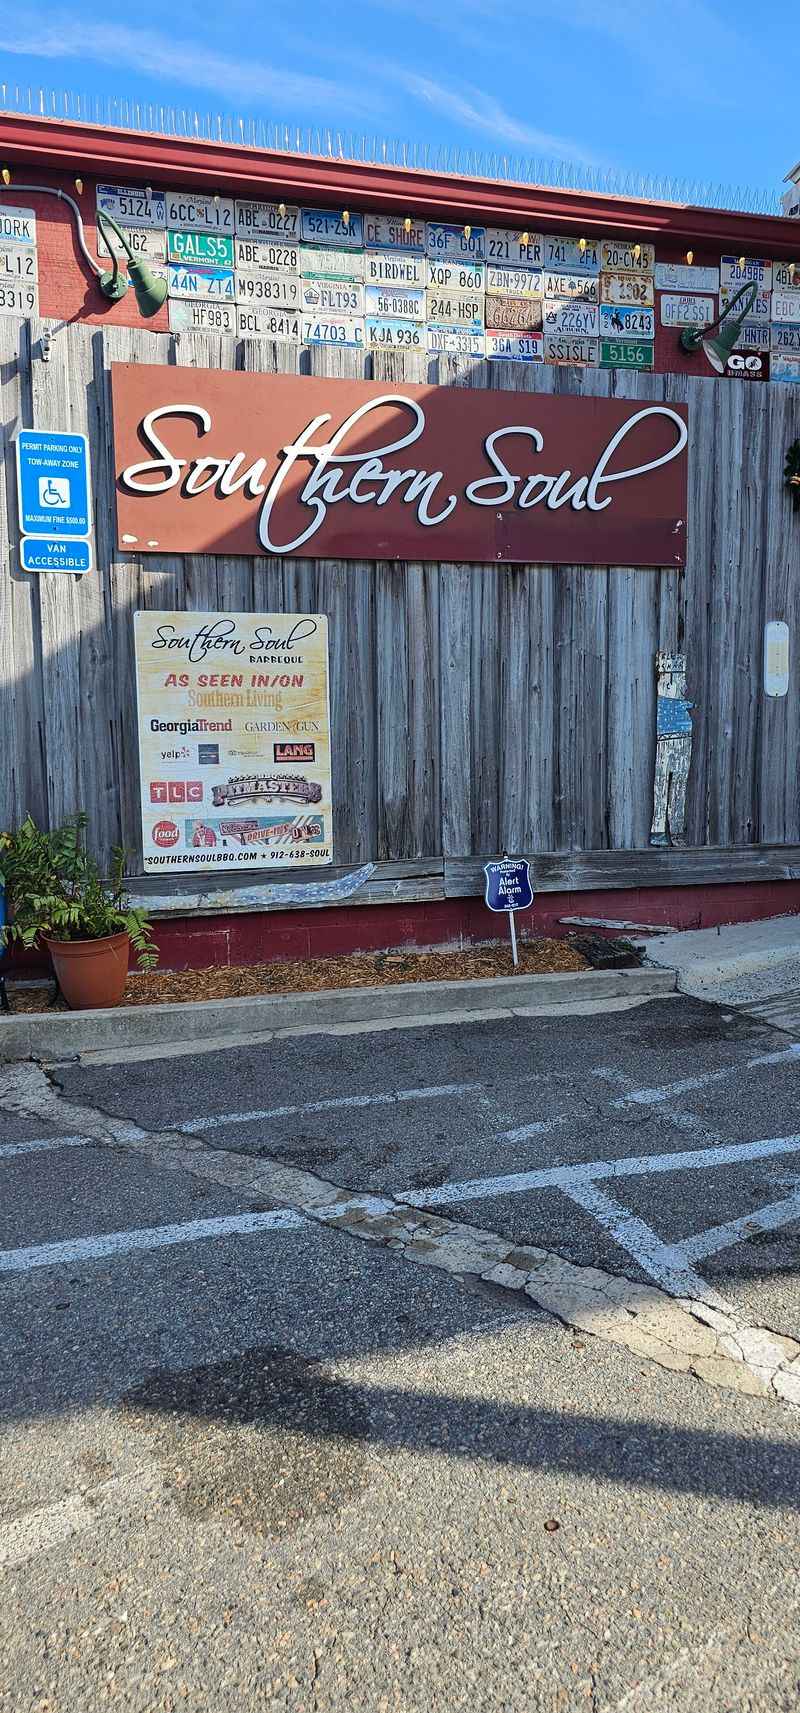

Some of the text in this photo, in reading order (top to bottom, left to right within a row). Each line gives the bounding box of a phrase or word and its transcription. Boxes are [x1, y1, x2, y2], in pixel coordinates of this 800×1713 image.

[120, 197, 151, 217] 5124
[169, 203, 231, 227] 6CC L12
[238, 209, 297, 231] ABE 0227
[173, 233, 227, 257] GALS5
[389, 227, 424, 248] SHORE
[238, 244, 260, 263] ABE
[269, 248, 297, 266] 0228
[489, 240, 540, 262] 221 PER
[549, 245, 566, 262] 741
[6, 255, 34, 275] L12
[183, 256, 218, 264] VERMONT
[370, 261, 419, 281] BIRDWEL
[430, 268, 481, 288] XQP 860
[730, 265, 764, 281] 204986
[172, 275, 197, 291] 44N
[238, 279, 297, 300] M938319
[490, 271, 540, 292] ZBN 9972
[547, 278, 596, 295] AXE 566
[321, 290, 358, 308] FLT93
[431, 300, 478, 319] 244-HSP
[193, 309, 229, 328] HF983
[240, 316, 298, 336] BCL 8414
[561, 312, 595, 329] 226YV
[625, 314, 651, 331] 8243
[305, 323, 362, 342] 74703 C
[370, 327, 420, 344] KJA 936
[518, 340, 538, 354] S19
[549, 344, 595, 362] SSISLE
[610, 346, 644, 362] 5156
[21, 442, 83, 453] PERMIT PARKING ONLY
[28, 458, 79, 468] TOW-AWAY ZONE
[123, 394, 688, 554] Southern Soul
[47, 544, 66, 553] VAN
[28, 557, 86, 567] ACCESSIBLE
[152, 619, 317, 663] Southern Soul
[249, 655, 304, 664] BARBEQUE
[164, 674, 304, 687] AS SEEN IN/ON
[188, 688, 283, 710] Southern Living
[161, 751, 180, 760] yelp
[276, 745, 313, 756] LANG
[155, 828, 178, 838] food
[271, 849, 330, 859] 912-638-SOUL
[491, 864, 524, 872] WARNING!
[499, 877, 519, 886] Alert
[498, 887, 521, 895] Alarm
